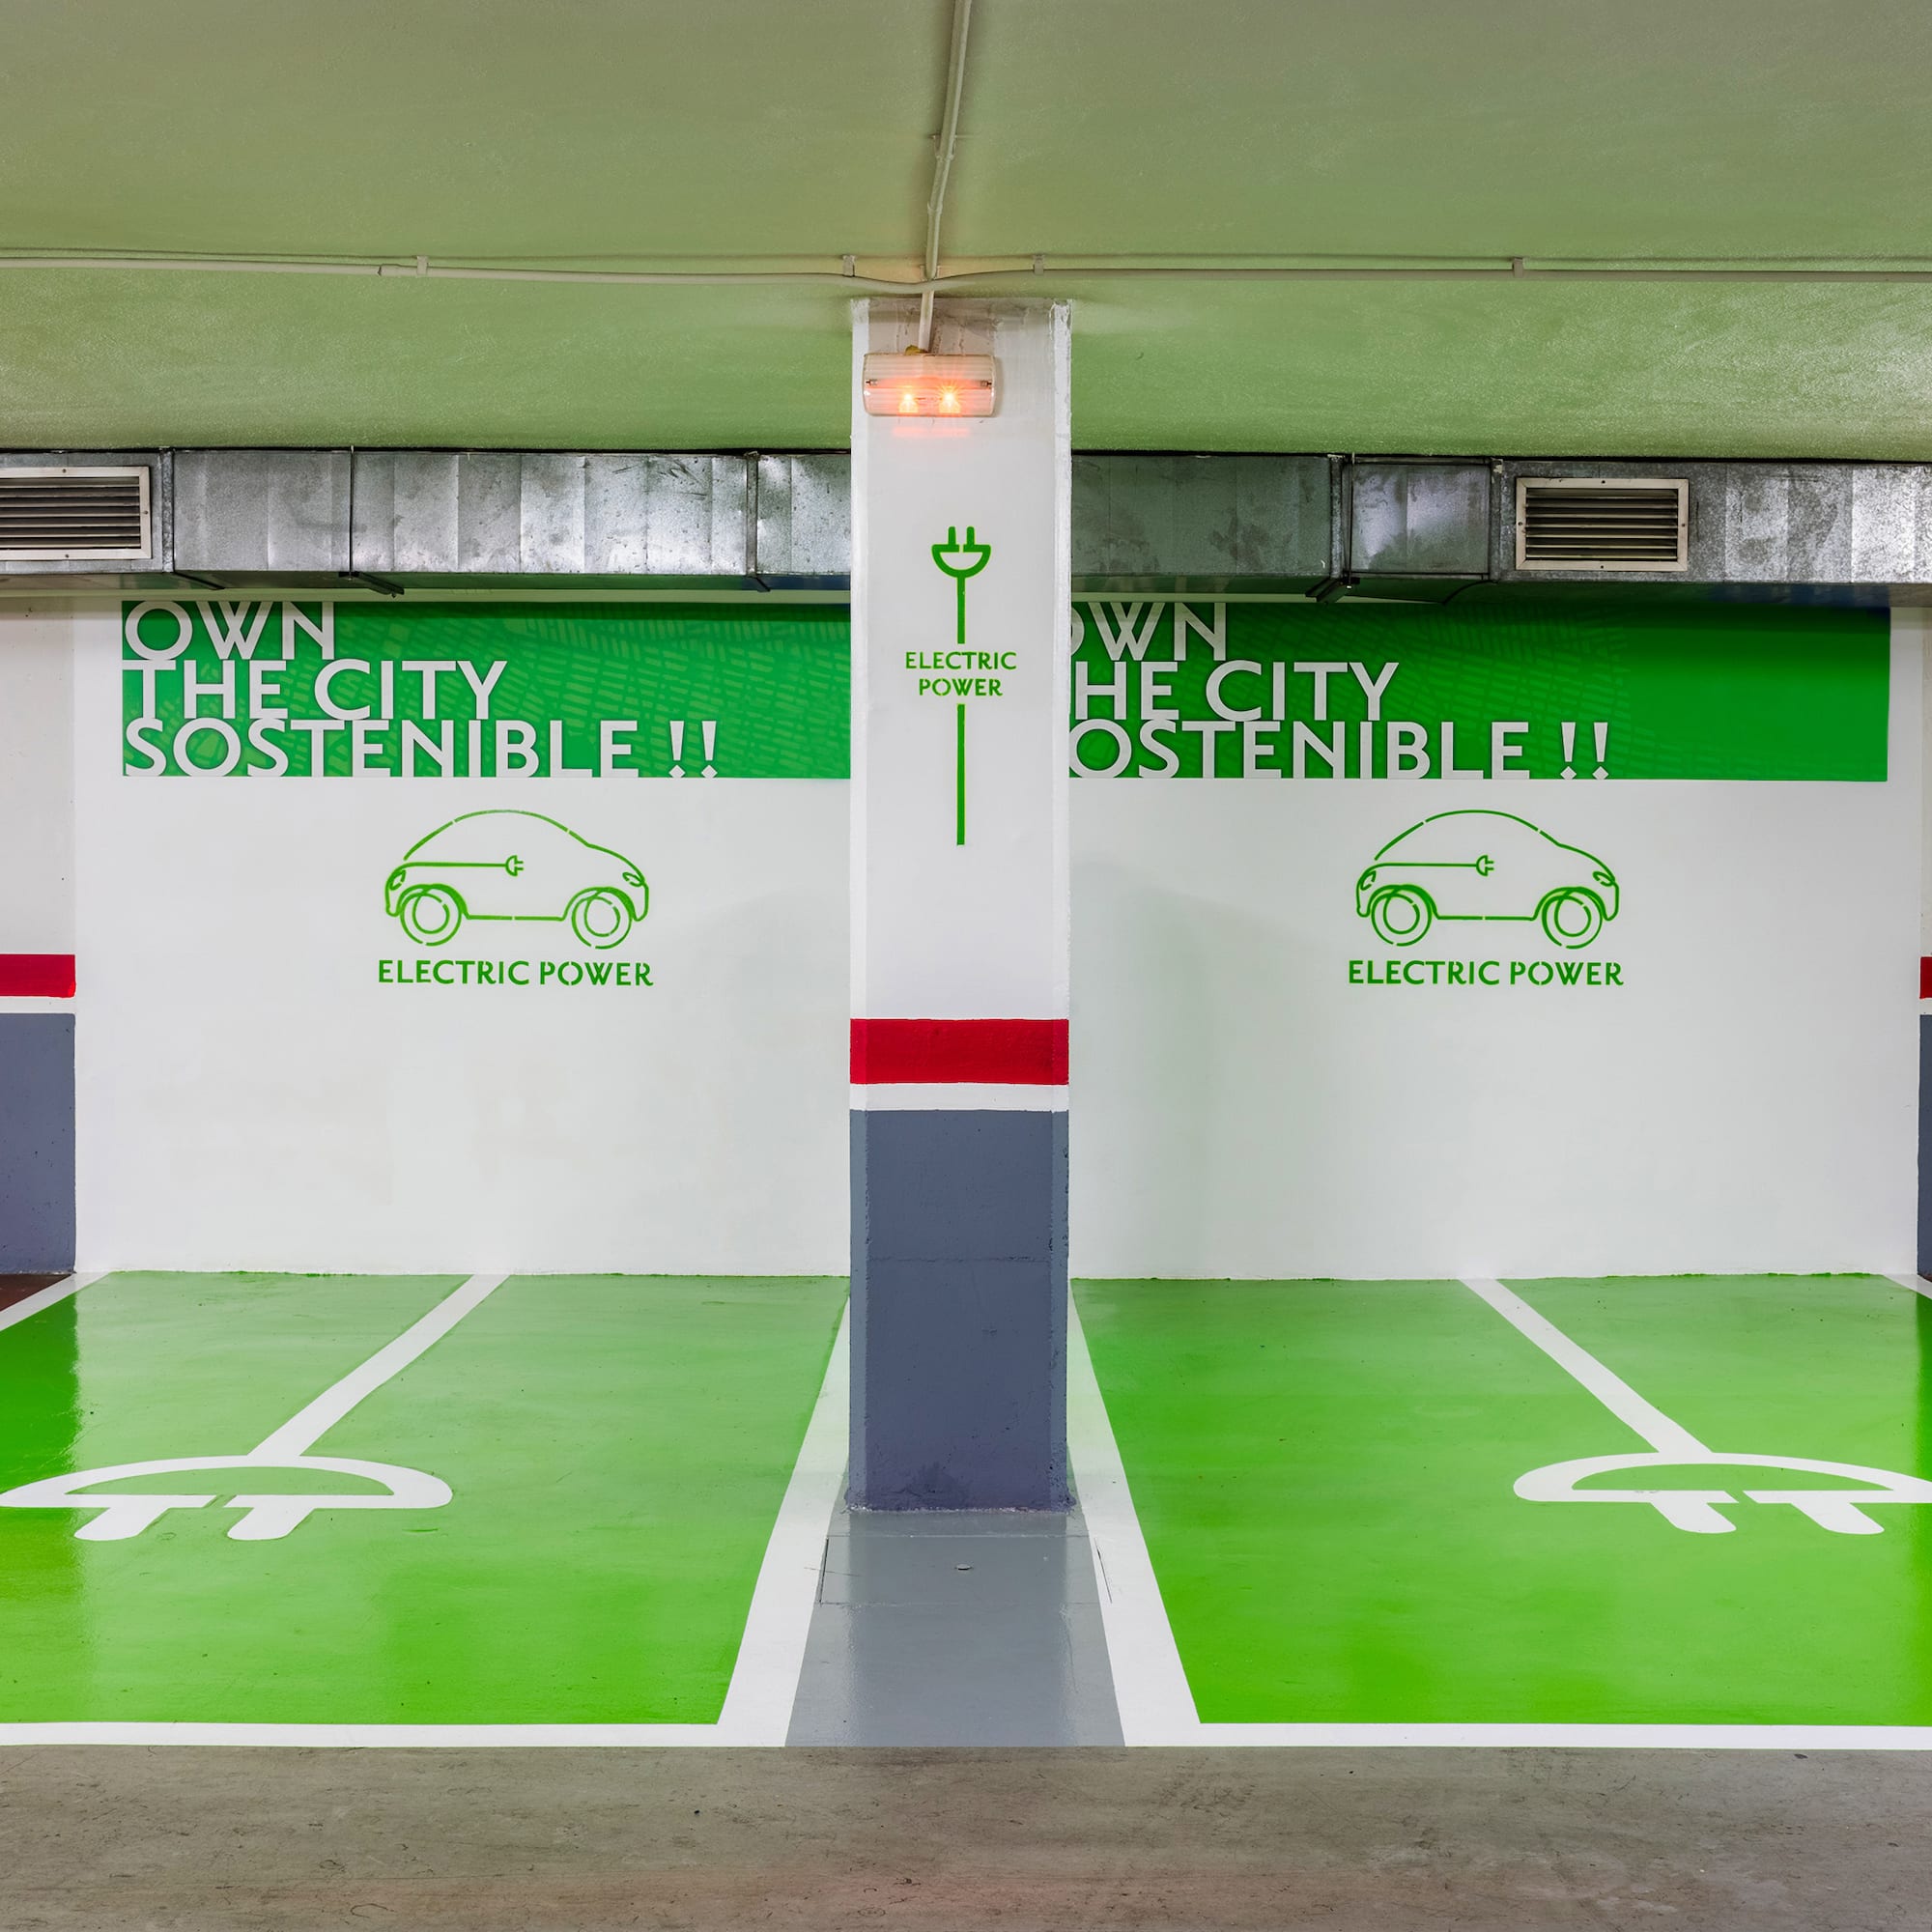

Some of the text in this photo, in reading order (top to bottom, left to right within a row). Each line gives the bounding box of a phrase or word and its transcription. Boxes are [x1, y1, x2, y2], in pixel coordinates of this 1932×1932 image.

[125, 601, 335, 661] OWN
[905, 651, 1017, 670] ELECTRIC
[1071, 602, 1227, 661] WN
[122, 659, 508, 721] THE CITY
[919, 678, 1004, 696] POWER
[1074, 659, 1400, 723] HE CITY
[125, 717, 718, 779] SOSTENIBLE !!
[1069, 718, 1609, 780] OSTENIBLE !!
[378, 959, 654, 986] ELECTRIC POWER
[1349, 959, 1624, 986] ELECTRIC POWER
